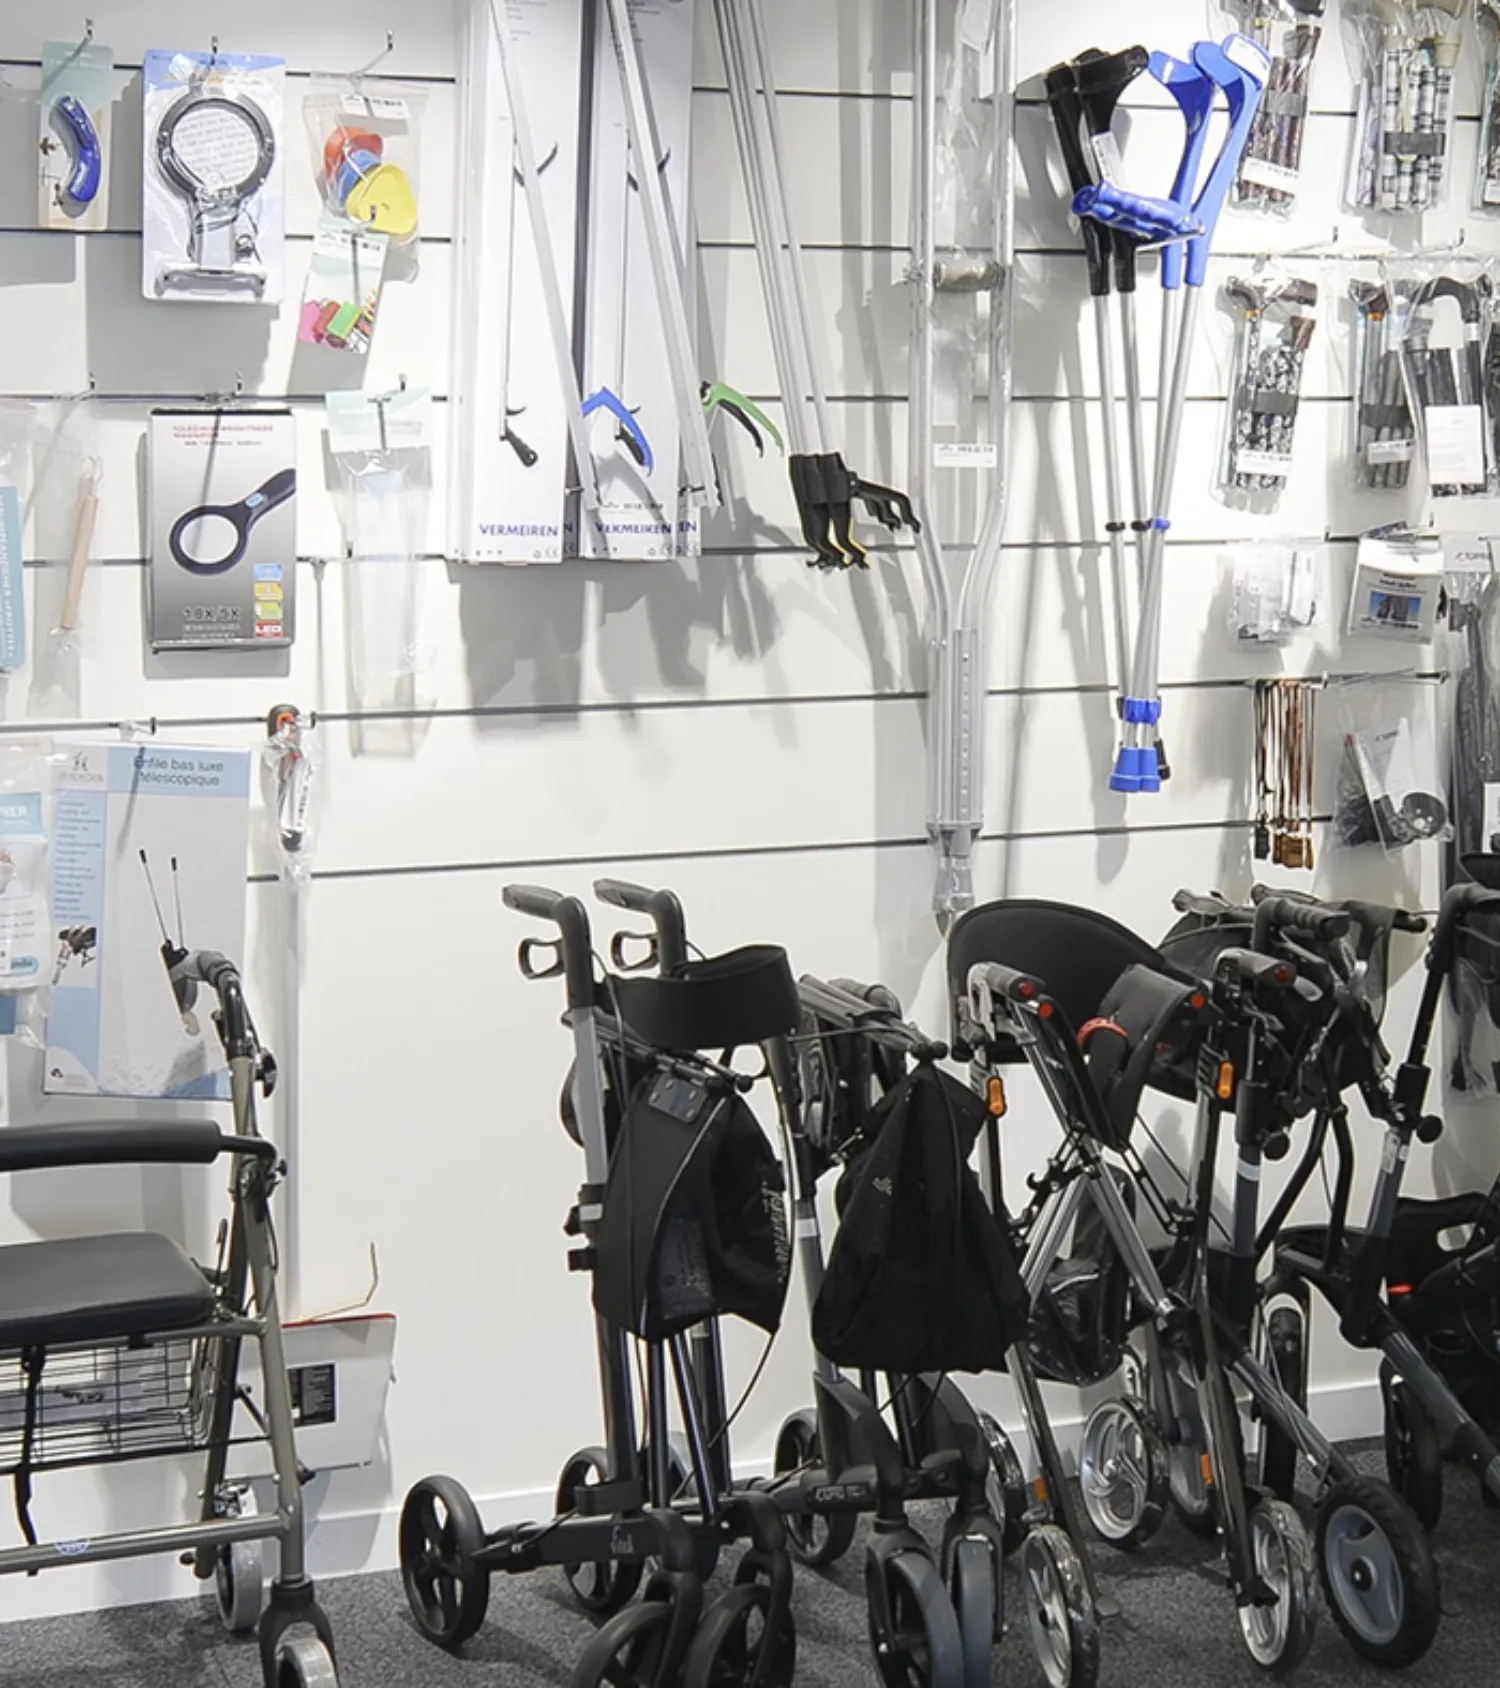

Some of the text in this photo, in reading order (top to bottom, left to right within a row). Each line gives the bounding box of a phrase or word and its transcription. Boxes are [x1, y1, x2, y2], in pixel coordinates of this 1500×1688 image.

[479, 523, 558, 537] VERMEIREN
[594, 521, 671, 535] VERMEIREN
[171, 758, 196, 772] bas
[198, 759, 224, 772] luxe
[140, 770, 219, 787] télescopique
